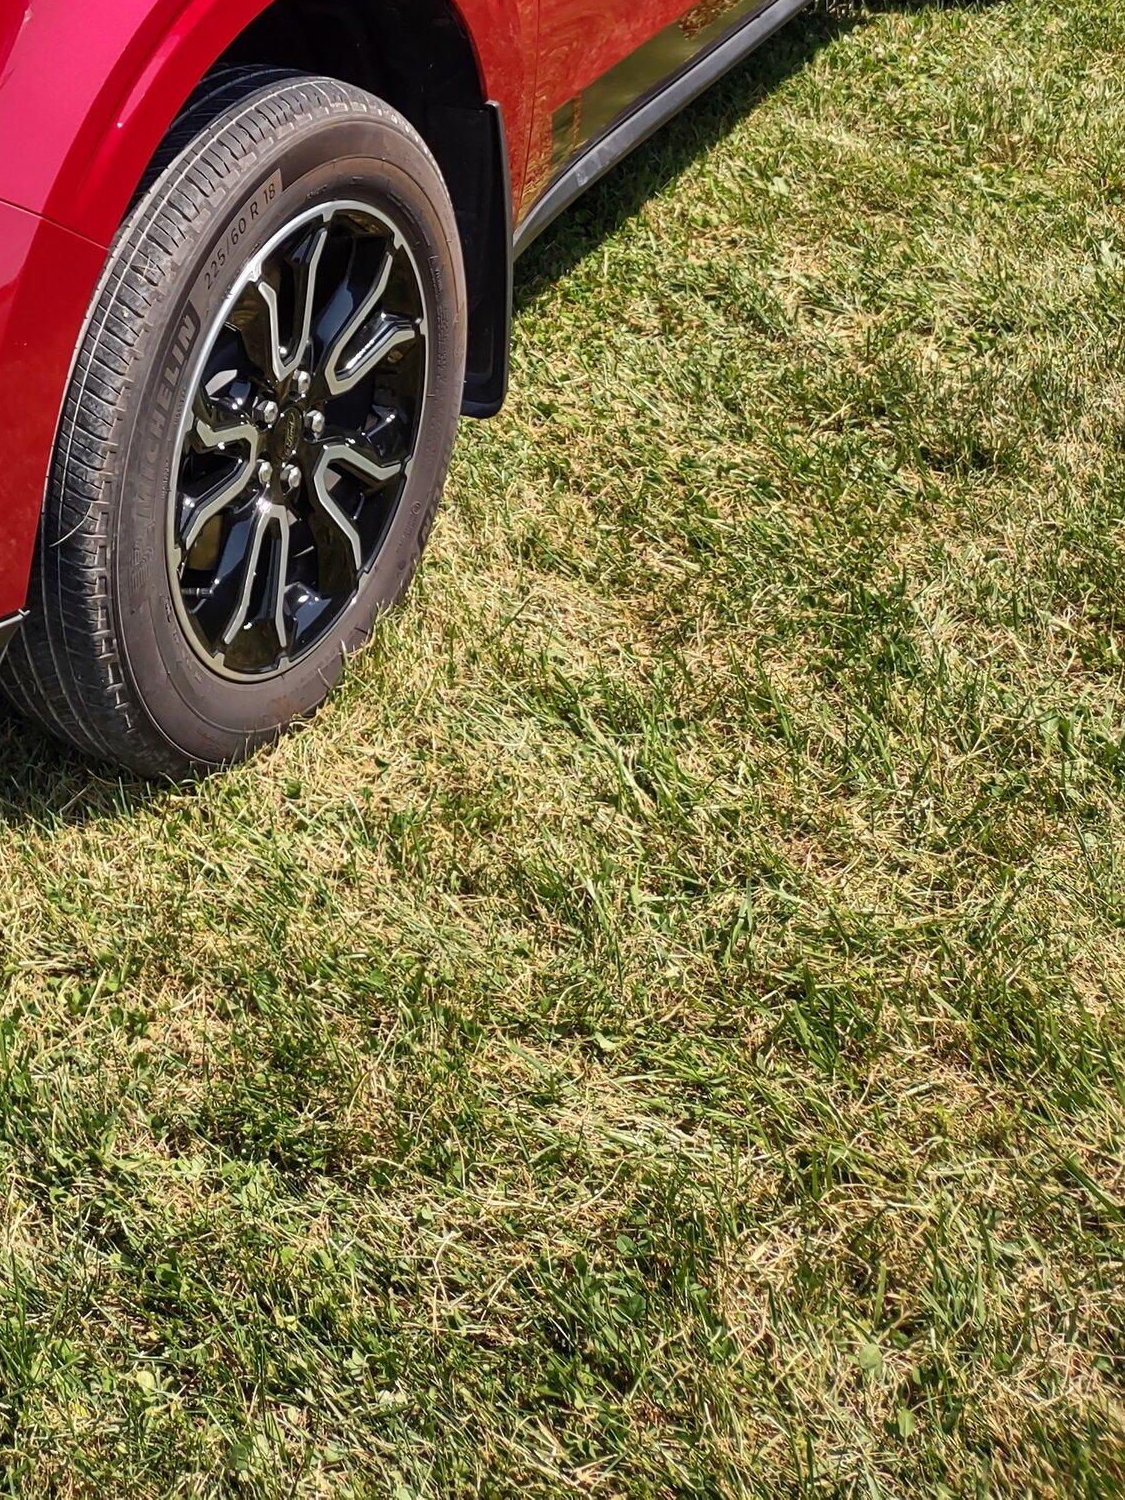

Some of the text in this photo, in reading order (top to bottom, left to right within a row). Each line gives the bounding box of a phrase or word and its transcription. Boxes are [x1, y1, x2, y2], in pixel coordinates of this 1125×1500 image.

[204, 183, 276, 290] 225/60 R 18
